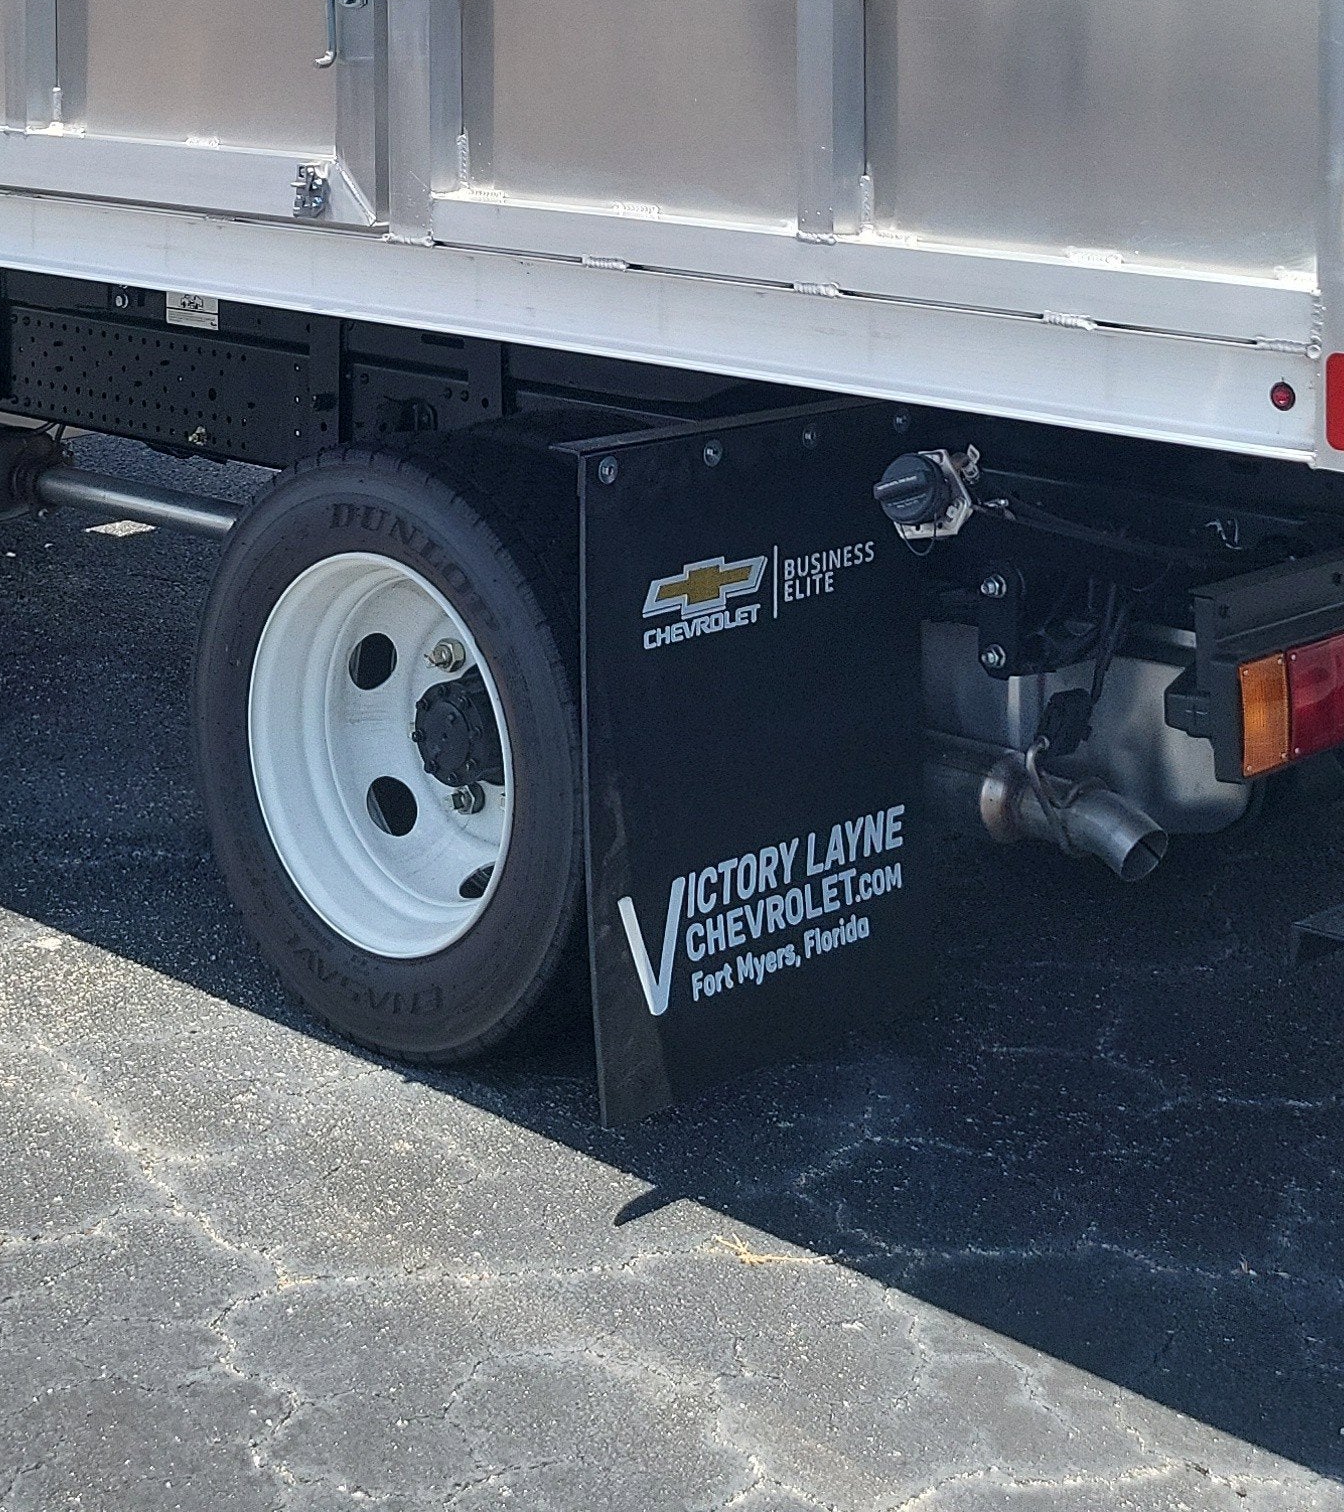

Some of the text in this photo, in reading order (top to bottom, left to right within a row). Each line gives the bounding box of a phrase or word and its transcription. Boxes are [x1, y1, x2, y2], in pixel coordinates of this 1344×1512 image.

[329, 502, 500, 631] DUNLOP
[783, 541, 875, 581] BUSINESS
[783, 571, 835, 603] ELITE
[643, 603, 761, 650] CHEVROLET
[617, 804, 905, 1016] VICTORY LAYNE
[685, 862, 903, 962] CHEVROLET.COM
[691, 914, 870, 1002] Fort Myers, Florida
